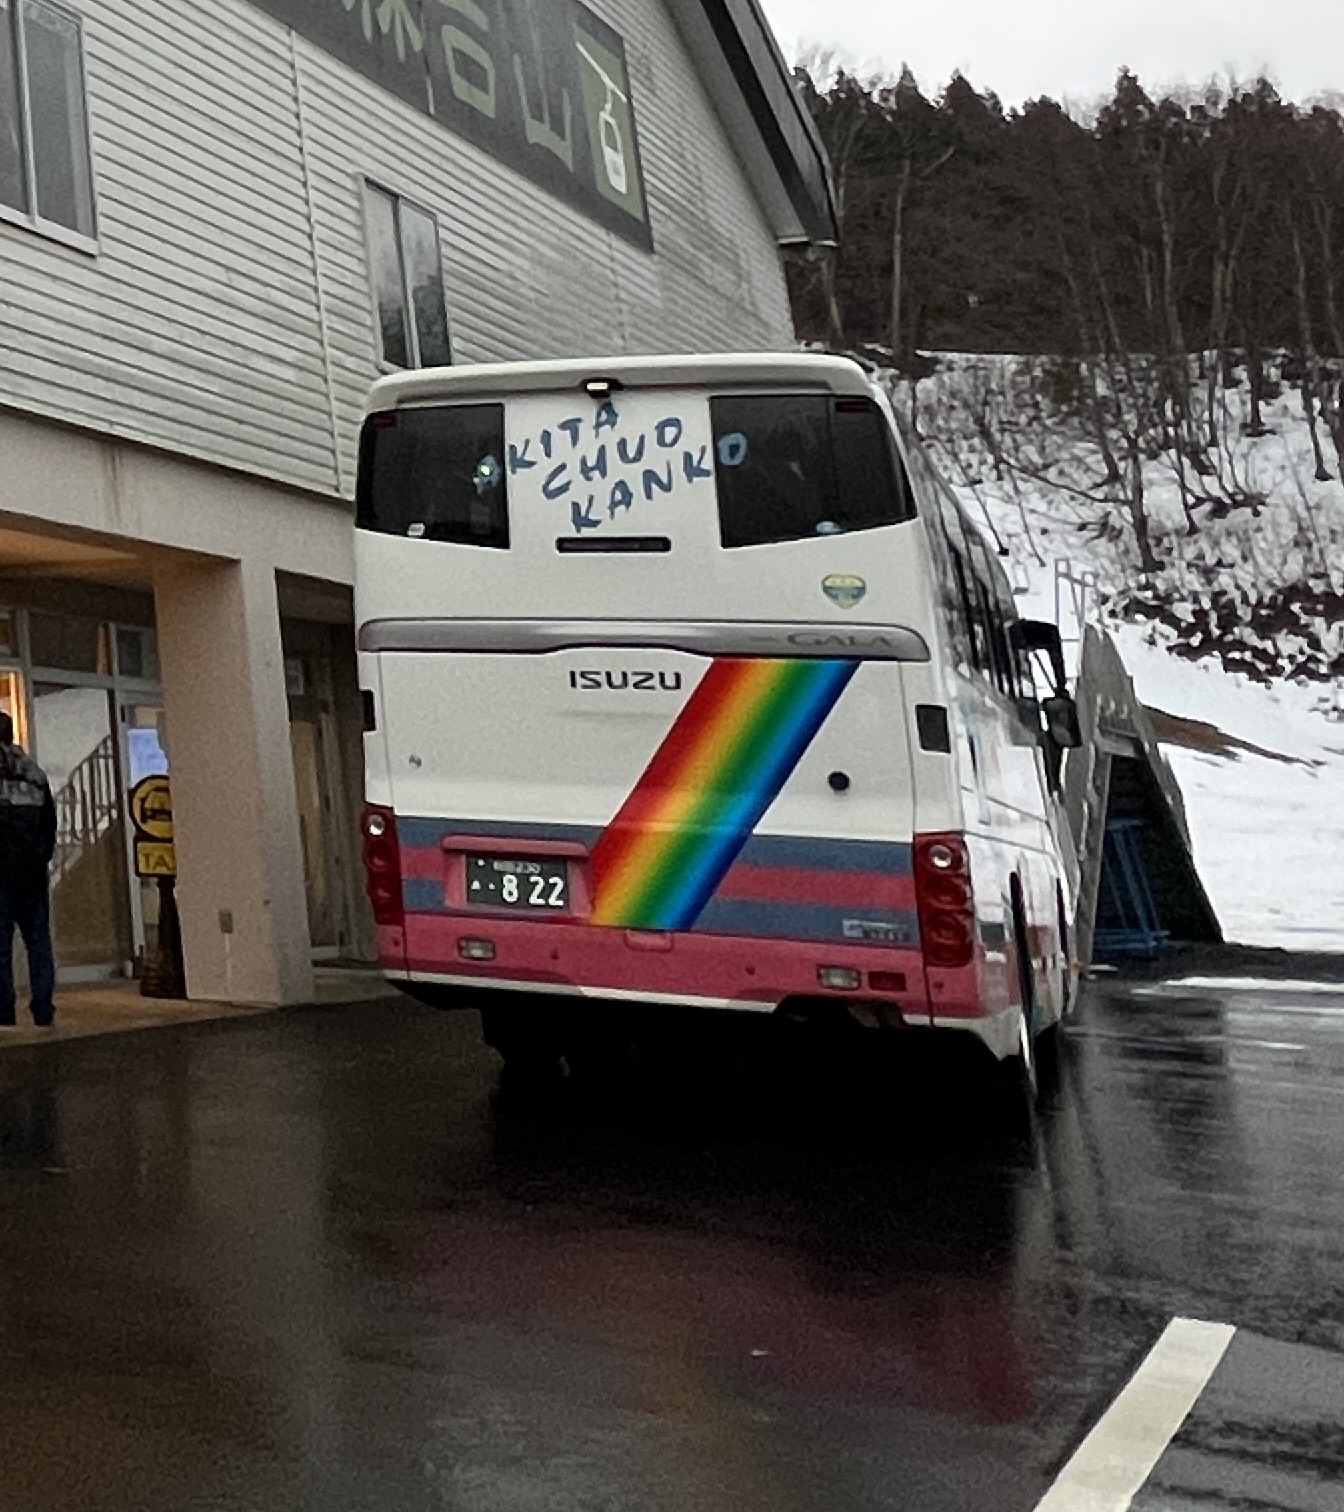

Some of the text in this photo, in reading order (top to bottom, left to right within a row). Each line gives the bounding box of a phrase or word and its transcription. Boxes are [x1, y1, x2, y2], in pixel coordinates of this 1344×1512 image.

[508, 400, 619, 475] KITA
[542, 416, 683, 500] CHUO
[570, 431, 748, 533] KANKO
[785, 631, 895, 648] GALA
[568, 670, 682, 690] ISUZU
